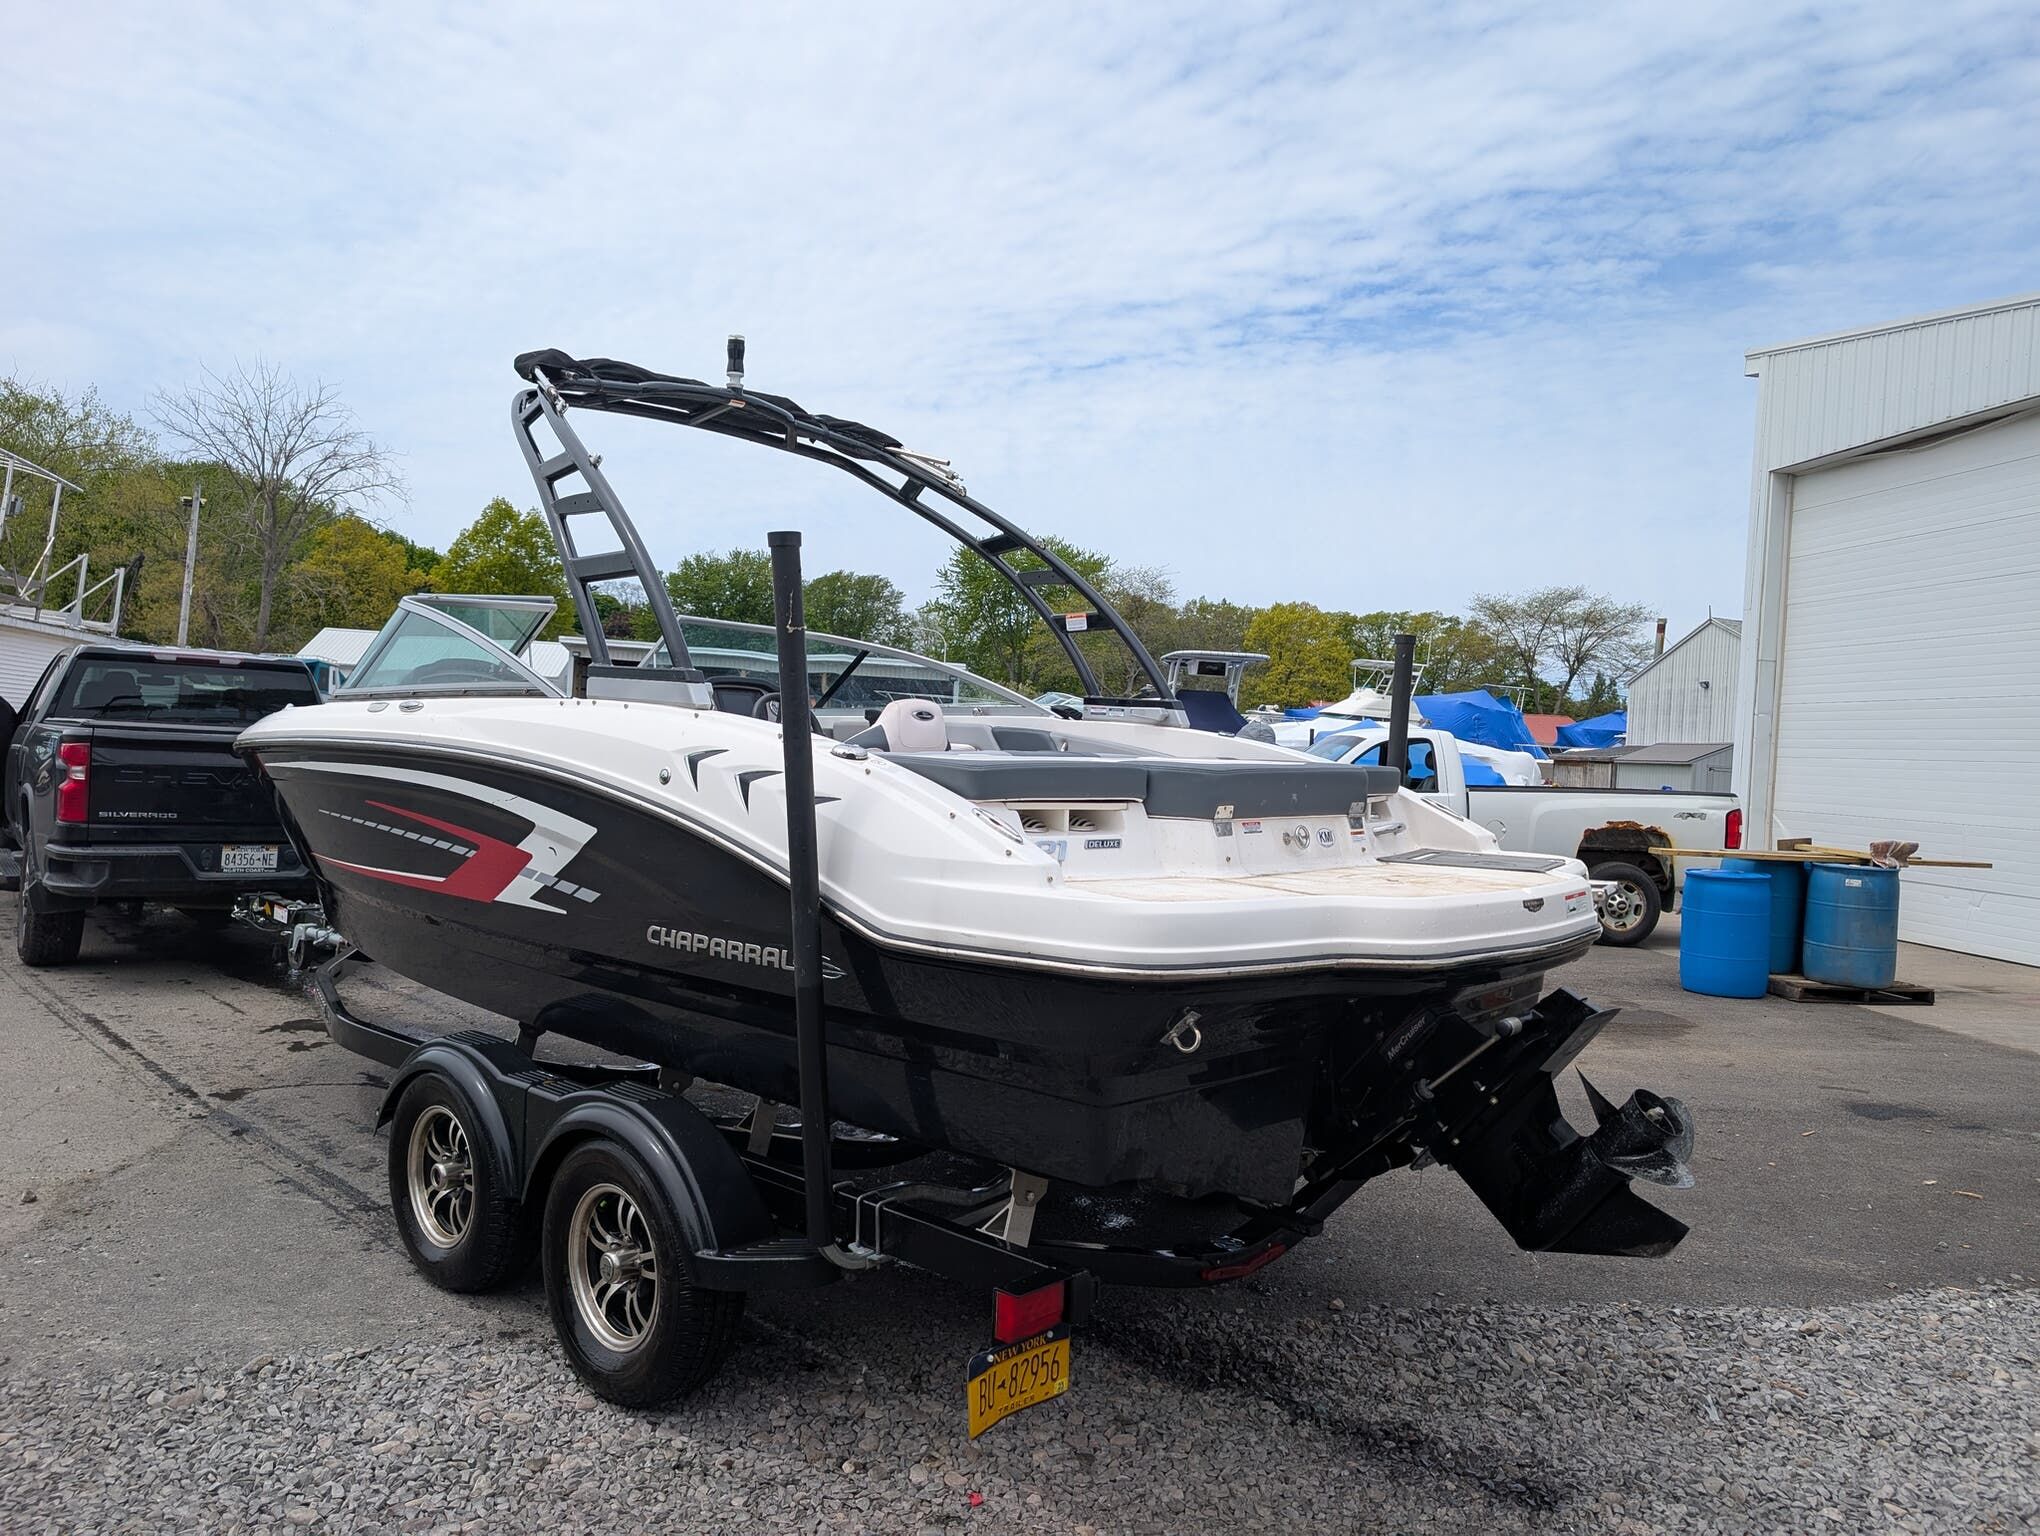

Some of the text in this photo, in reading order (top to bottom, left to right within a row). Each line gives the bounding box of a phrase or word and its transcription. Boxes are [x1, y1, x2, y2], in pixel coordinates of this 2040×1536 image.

[99, 811, 178, 819] SILVERADO
[1088, 840, 1120, 849] DELUXE
[646, 925, 796, 971] CHAPARRAL
[1387, 1015, 1426, 1060] MerCruiser
[993, 1335, 1047, 1364] NEW YORK
[998, 1394, 1035, 1415] TRAILER
